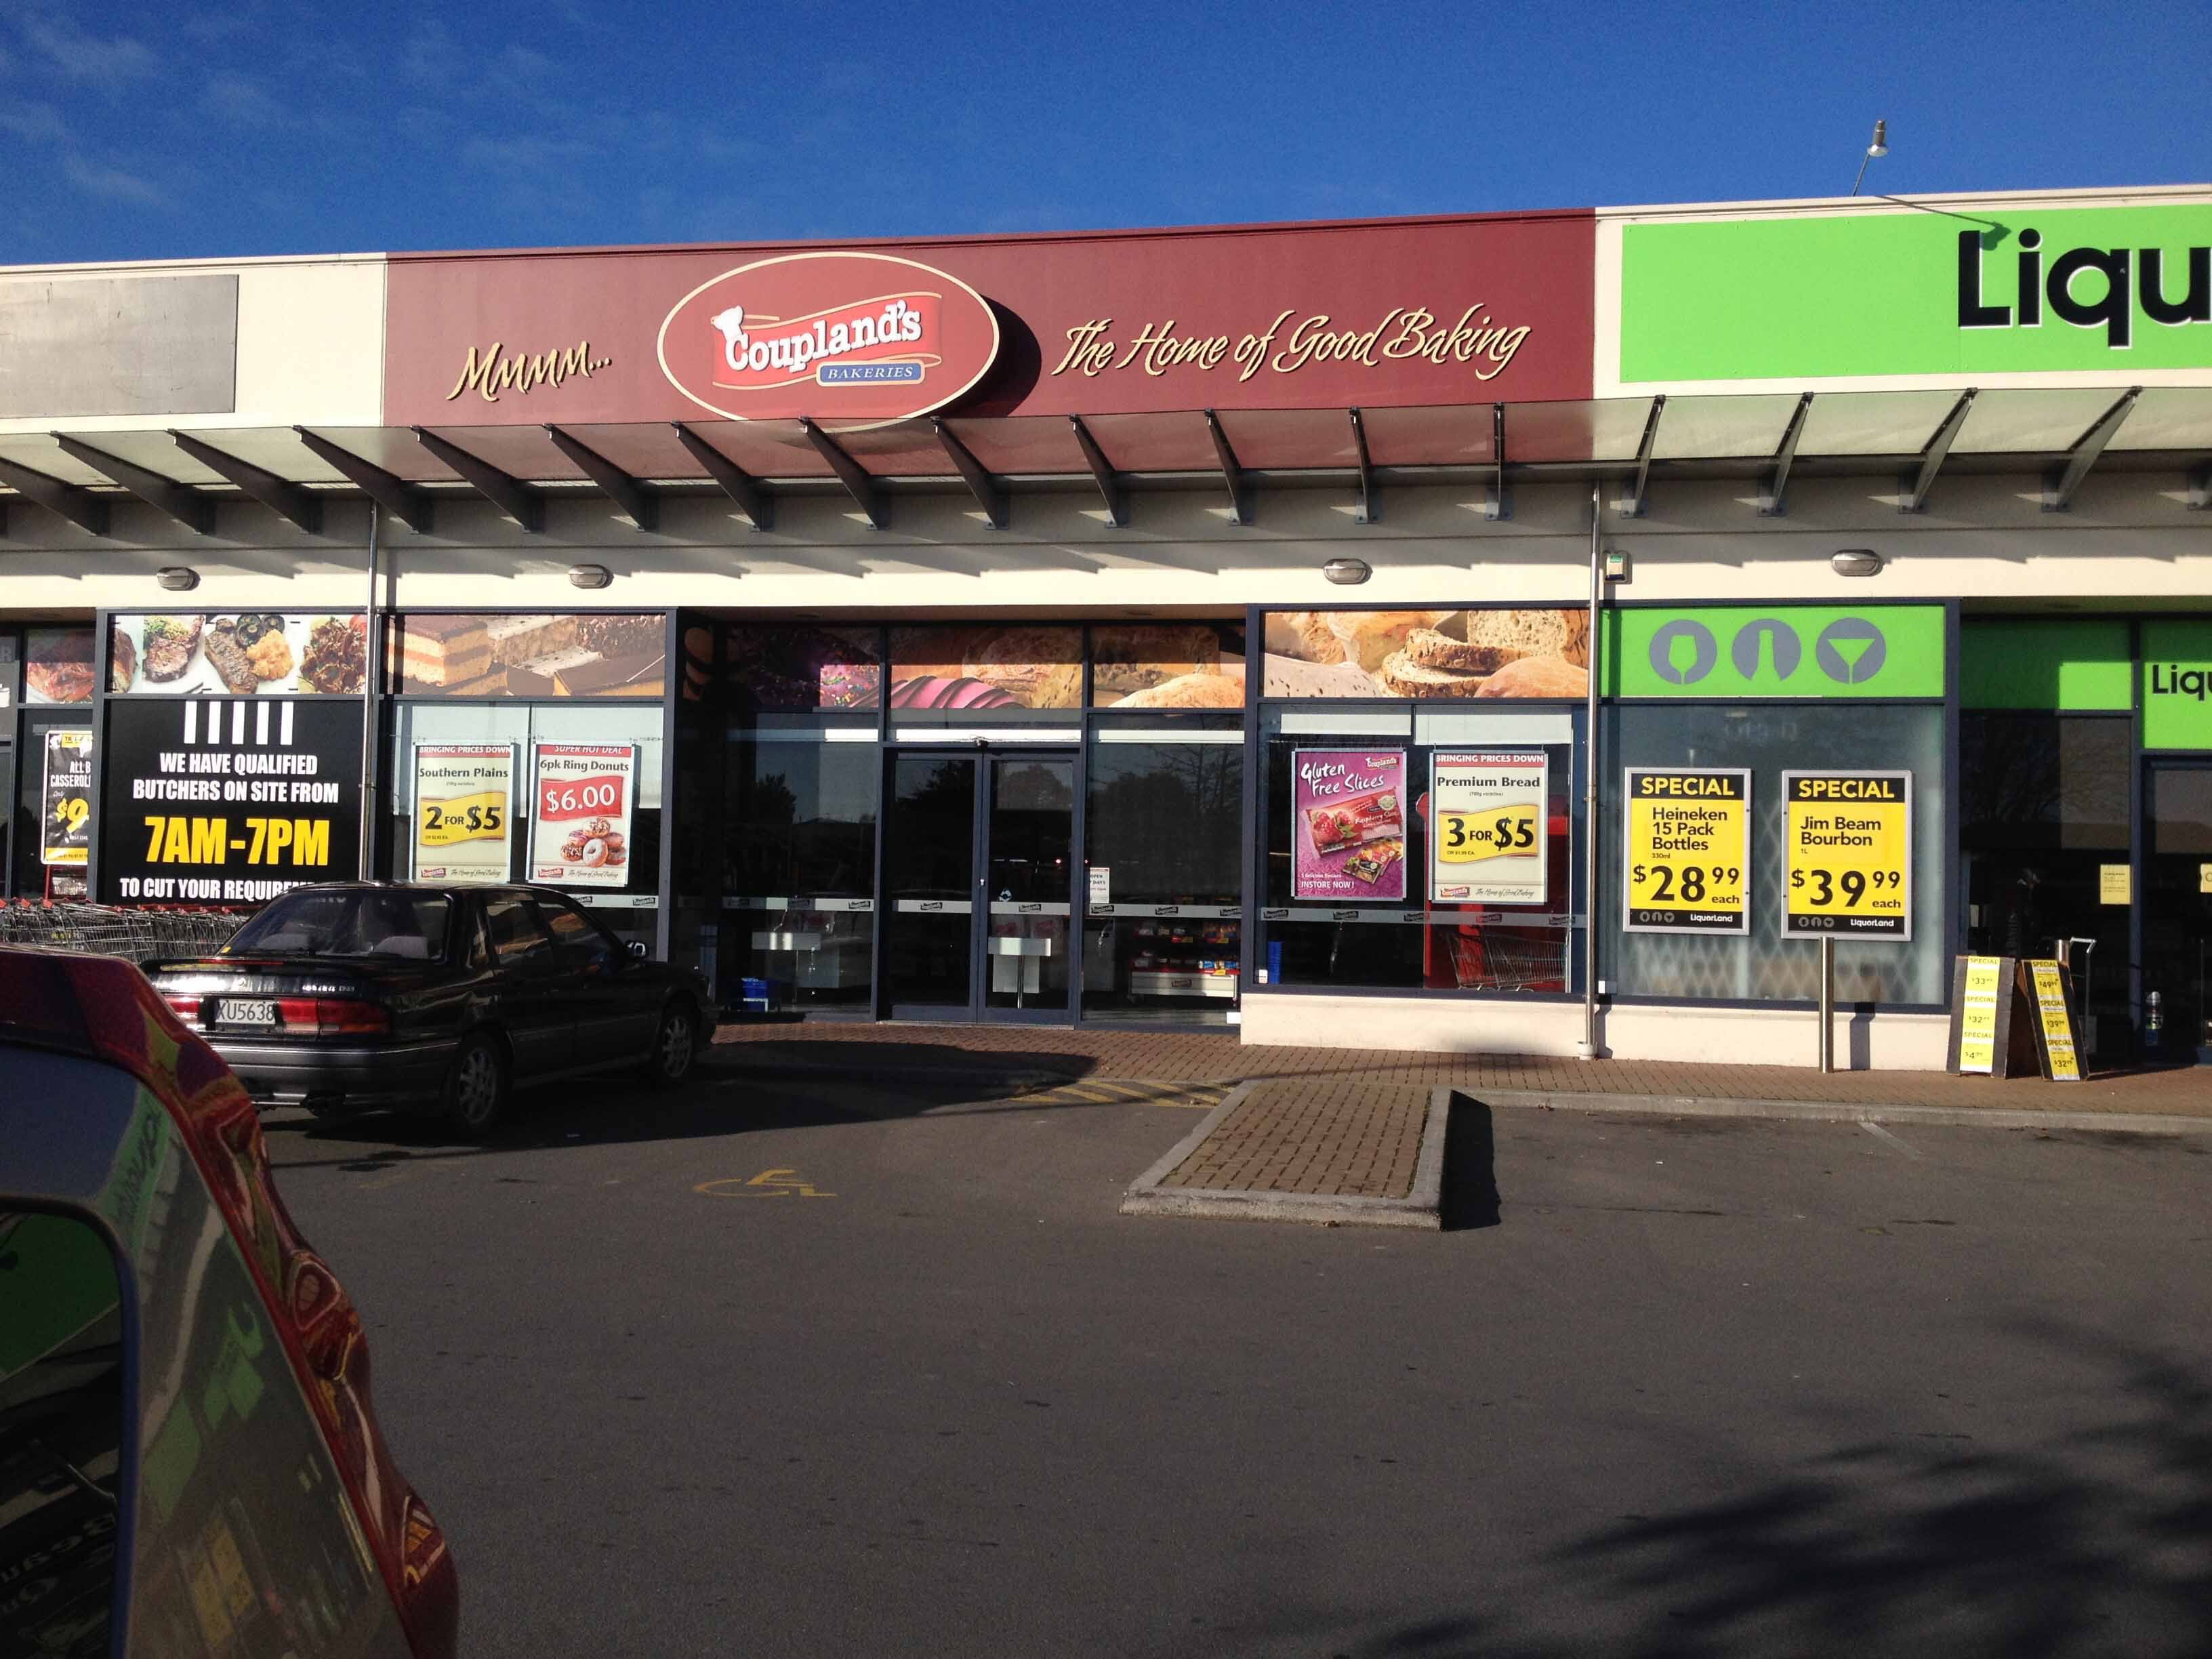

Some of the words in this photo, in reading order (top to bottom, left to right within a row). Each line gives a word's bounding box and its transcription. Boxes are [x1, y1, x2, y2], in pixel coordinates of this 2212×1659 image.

[724, 300, 922, 373] Coupland's
[1051, 319, 1115, 376] The
[1116, 320, 1228, 376] Home
[1239, 310, 1294, 382] of
[1272, 308, 1403, 373] Good
[1382, 303, 1531, 381] Baking
[827, 367, 914, 380] BAKERIES
[159, 753, 186, 773] WE
[189, 754, 231, 774] HAVE
[234, 754, 318, 776] QUALIFIED
[419, 767, 470, 777] Southern
[474, 767, 508, 777] Plains
[540, 759, 560, 771] 6pk
[563, 760, 588, 772] Ring
[591, 761, 629, 771] Donuts
[1300, 762, 1345, 785] Gluten
[133, 779, 220, 801] BUTCHERS
[224, 781, 247, 801] ON
[251, 781, 288, 802] SITE
[291, 783, 339, 803] FROM
[1312, 779, 1340, 797] Free
[1344, 773, 1384, 792] Slices
[1437, 777, 1496, 787] Premium
[1502, 777, 1540, 787] Bread
[1641, 777, 1735, 796] SPECIAL
[1799, 780, 1895, 798] SPECIAL
[546, 784, 615, 813] $6.00
[425, 806, 443, 830] 2
[445, 816, 464, 825] FOR
[466, 805, 501, 833] $5
[1652, 806, 1727, 821] Heineken
[1652, 822, 1672, 835] 15
[1677, 821, 1714, 836] Pack
[1800, 816, 1829, 830] Jim
[1835, 817, 1881, 830] Beam
[1447, 817, 1465, 847] 3
[1469, 830, 1492, 840] FOR
[1494, 817, 1534, 851] $5
[1801, 832, 1872, 846] Bourbon
[1652, 837, 1708, 851] Bottles
[120, 878, 140, 897] TO
[143, 878, 176, 898] CUT
[178, 879, 221, 899] YOUR
[1711, 895, 1740, 904] each
[1872, 899, 1901, 908] each
[216, 999, 274, 1022] XU5638
